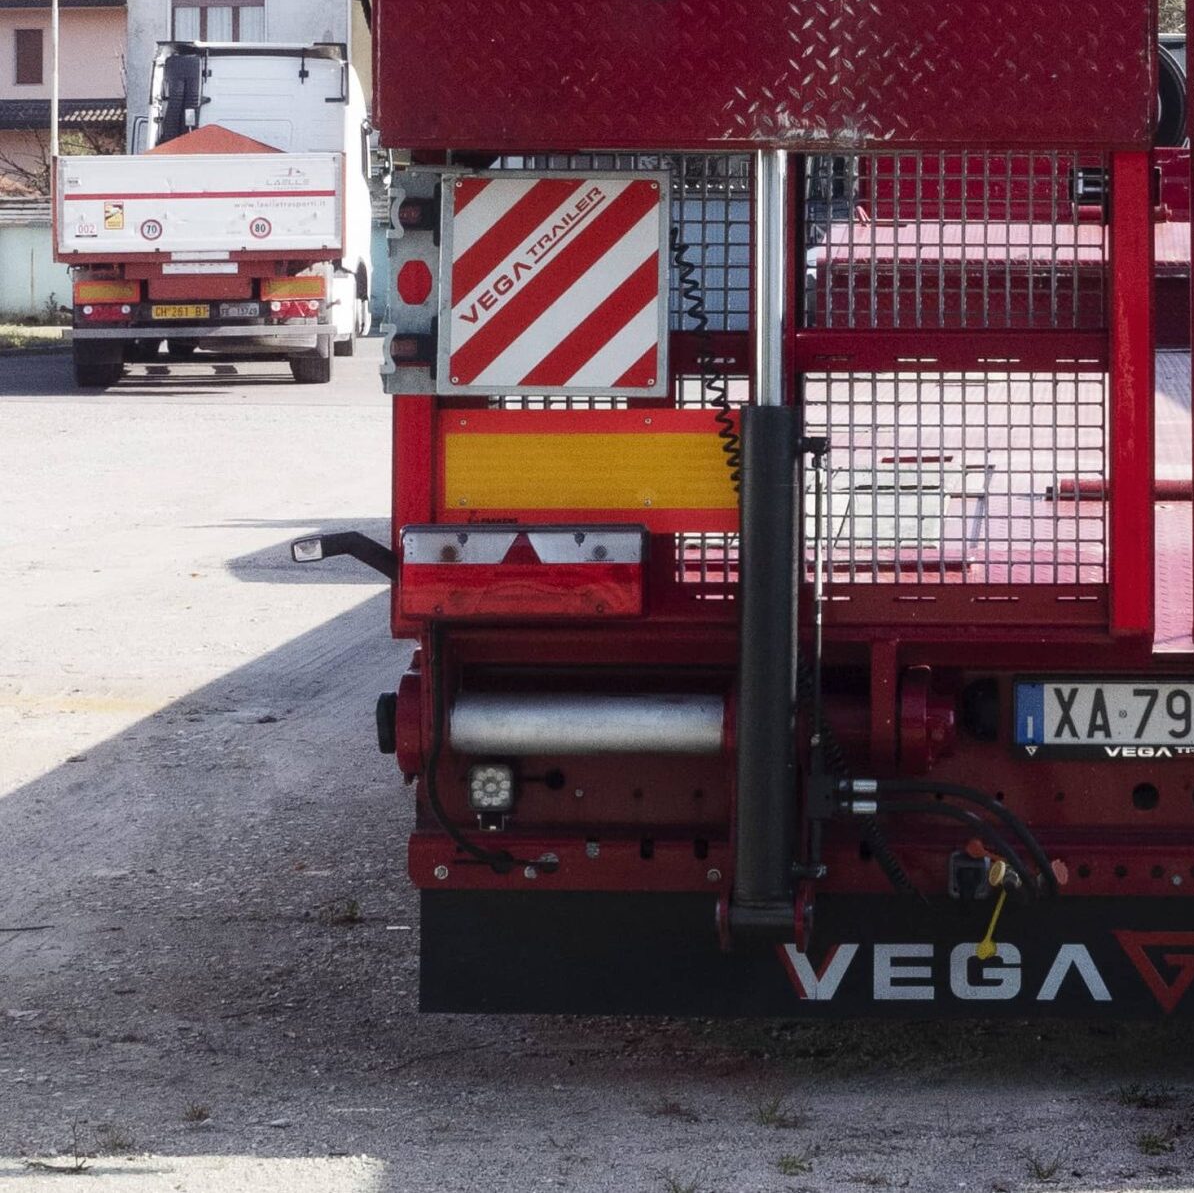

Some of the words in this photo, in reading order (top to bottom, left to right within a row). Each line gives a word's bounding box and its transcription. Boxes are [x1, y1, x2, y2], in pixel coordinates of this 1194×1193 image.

[78, 224, 95, 234] 002
[146, 224, 157, 234] 70
[254, 223, 266, 233] 80
[459, 261, 533, 325] VEGA
[526, 187, 606, 258] TRAILER
[1053, 687, 1112, 739] XA
[1105, 746, 1173, 757] VEGA
[783, 942, 1113, 1001] VEGA
